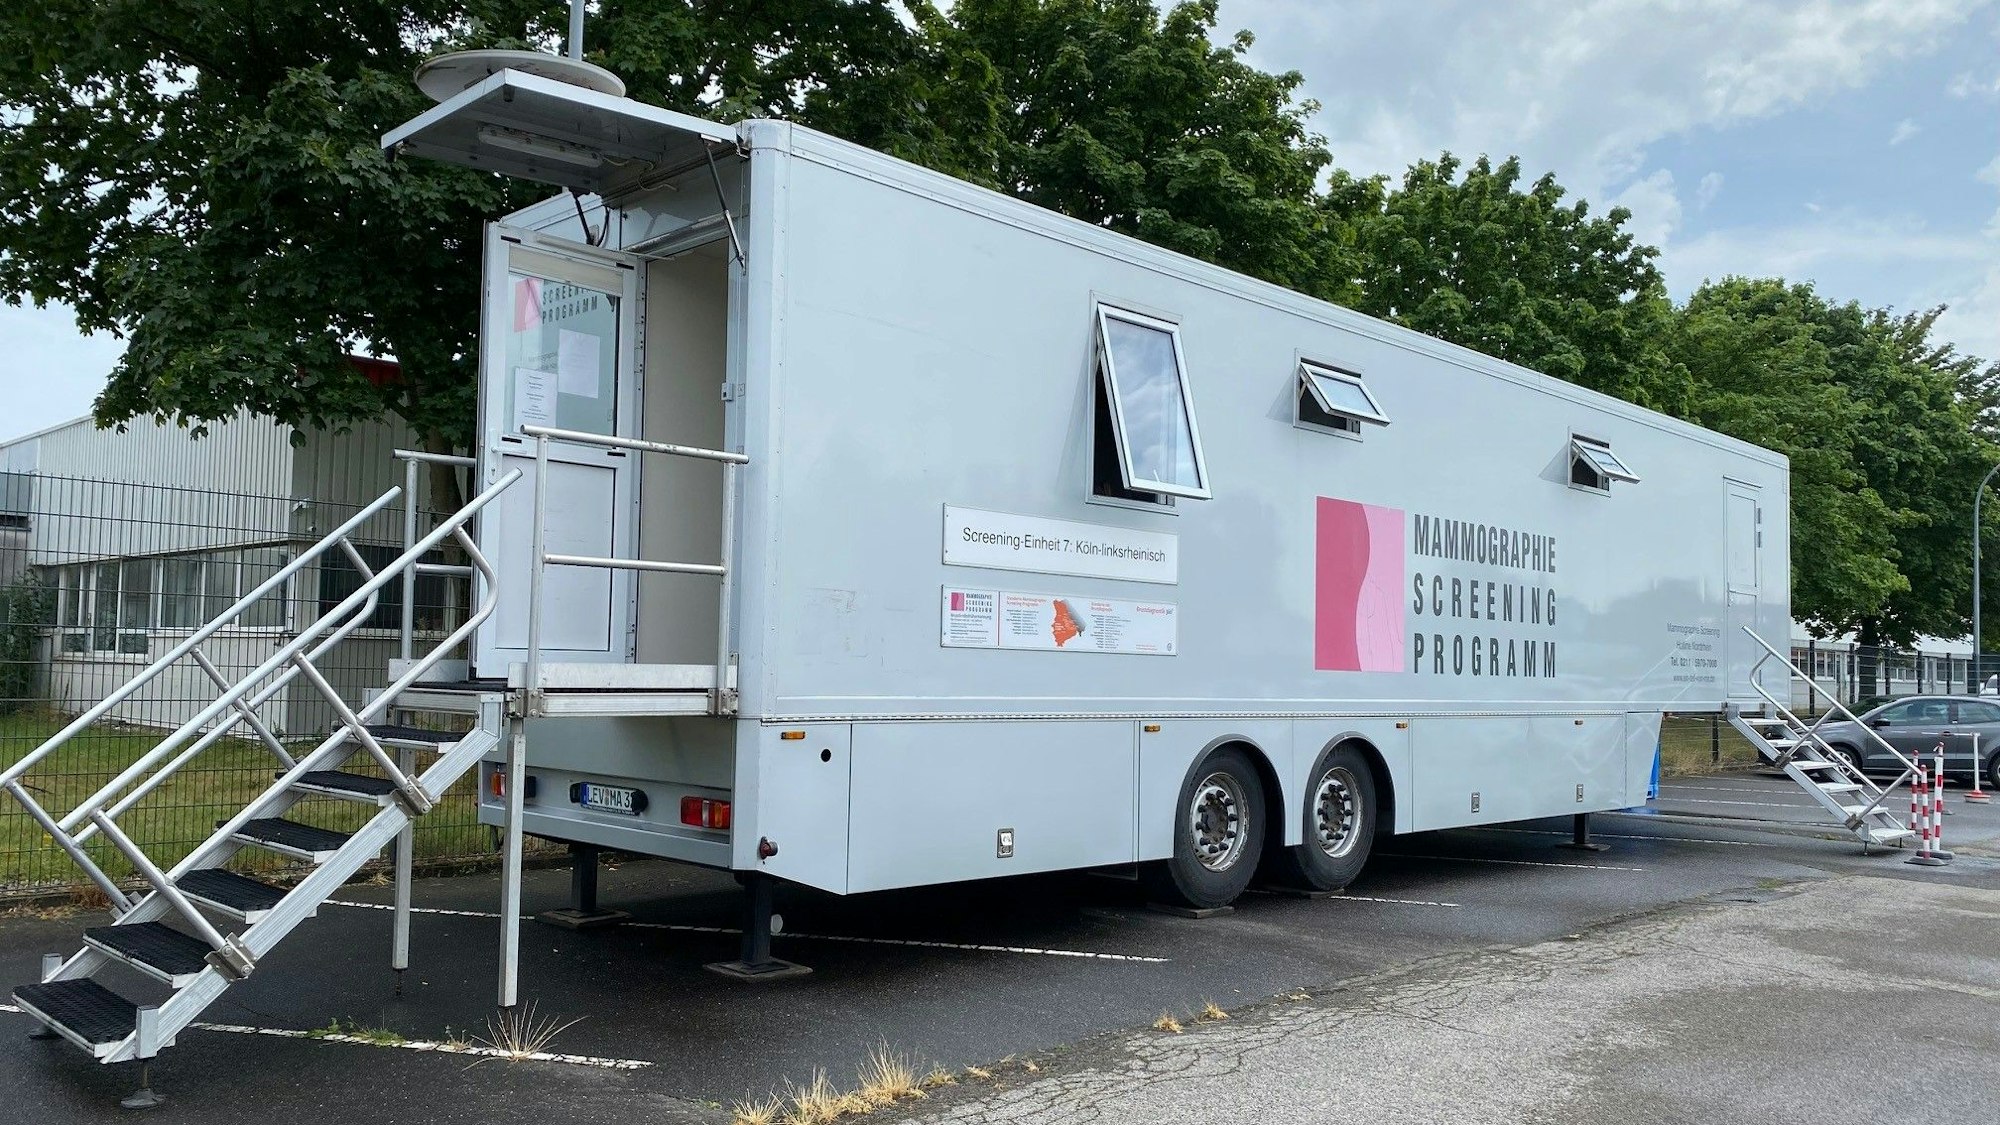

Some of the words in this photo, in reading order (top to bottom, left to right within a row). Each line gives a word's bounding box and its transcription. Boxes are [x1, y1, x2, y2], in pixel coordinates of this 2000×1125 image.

[542, 295, 598, 325] PROGRAMM
[962, 527, 1060, 552] Screening-Einheit
[1063, 539, 1073, 553] 7:
[1075, 540, 1167, 563] Köln-linksrheinisch
[1414, 513, 1556, 573] MAMMOGRAPHIE
[1413, 572, 1556, 626] SCREENING
[1413, 633, 1556, 678] PROGRAMM
[587, 786, 604, 805] LEV
